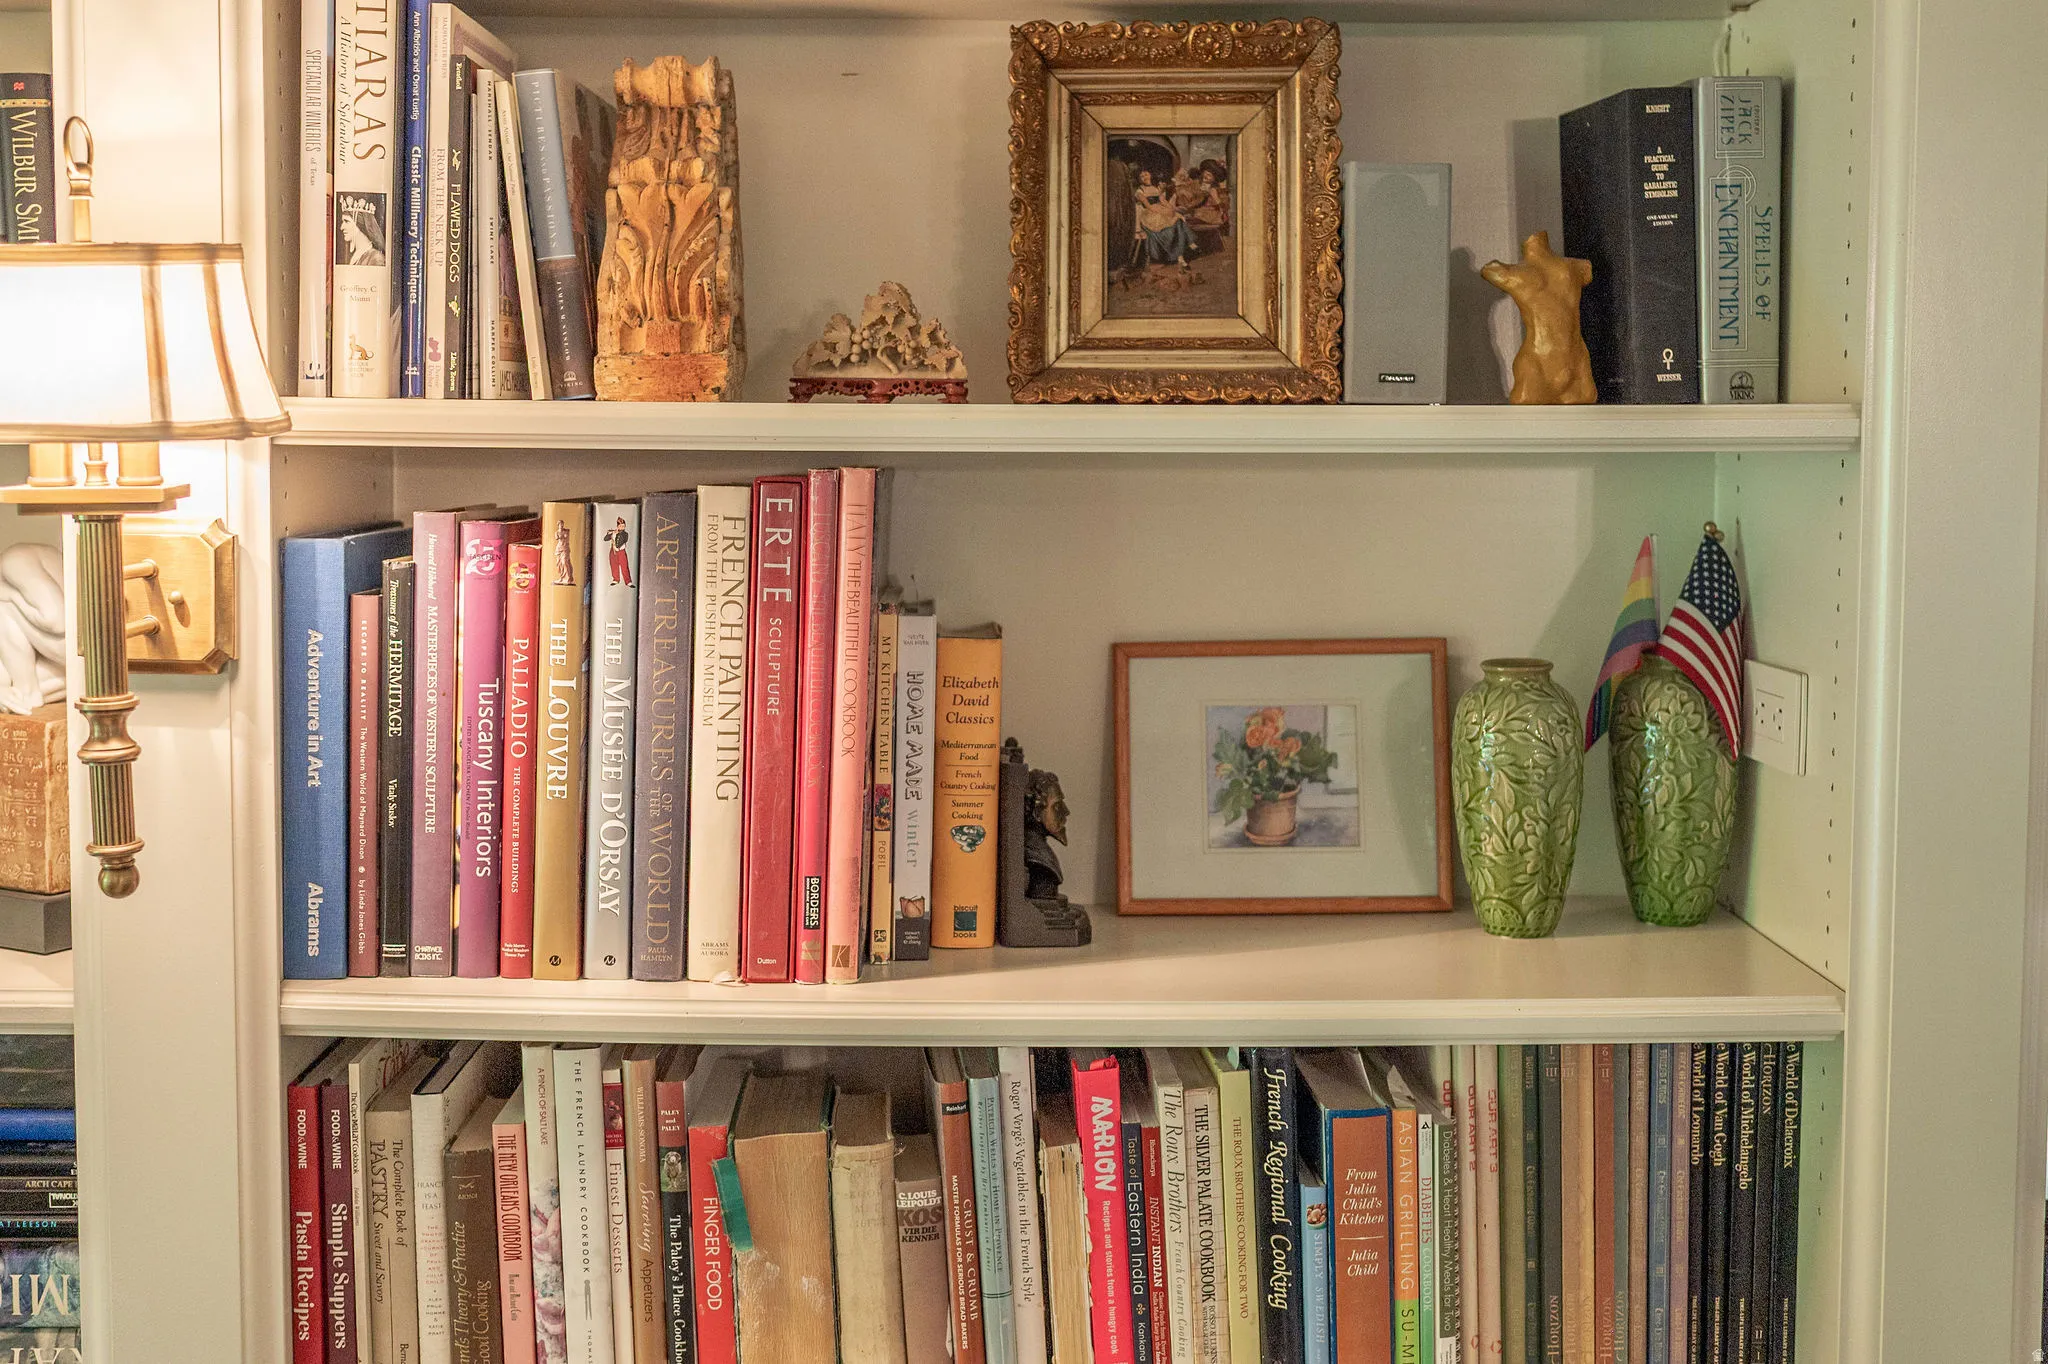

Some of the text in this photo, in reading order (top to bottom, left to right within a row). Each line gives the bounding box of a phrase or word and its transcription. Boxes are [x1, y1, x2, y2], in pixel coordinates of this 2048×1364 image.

[413, 11, 421, 26] Ann
[413, 29, 421, 56] Albrizio
[305, 50, 321, 152] SPECTACULAR WINERIES
[338, 16, 351, 164] A History of Splendour
[353, 0, 387, 160] TIARAS
[412, 75, 420, 97] Osnat
[411, 99, 420, 120] Lustig
[1646, 104, 1670, 113] KNIGHT
[1719, 94, 1734, 146] ZIPES
[1738, 96, 1753, 145] JACK
[10, 109, 38, 197] WILBUR
[408, 146, 421, 304] Classic Millinery Techniques
[449, 184, 461, 282] FLAWED DOGS
[1714, 183, 1742, 345] ENCHANTMENT
[1656, 374, 1682, 382] WEISER
[1729, 390, 1754, 400] VIKING
[605, 618, 623, 666] THE
[702, 514, 719, 726] FROM THE PUSHKIN MUSEUM
[360, 662, 366, 674] TO
[388, 579, 402, 737] Treasures of the HERMITAGE
[716, 514, 746, 801] FRENCH PAINTING
[767, 617, 782, 716] SCULPTURE
[942, 676, 999, 691] Elizabeth
[307, 629, 323, 787] Adventure in Art
[425, 606, 438, 833] MASTERPIECES OF WESTERN SCULPTURE
[546, 618, 577, 800] THE LOUVRE
[646, 512, 680, 943] ART TREASURES OF THE WORLD
[906, 671, 925, 734] HOME
[945, 711, 994, 725] Classics
[952, 694, 990, 707] David
[359, 773, 367, 794] World
[473, 678, 499, 877] Tuscany Interiors
[511, 637, 529, 893] PALLADIO THE COMPLETE BUILDINGS
[905, 740, 923, 800] MADE
[956, 770, 982, 779] French
[357, 806, 366, 837] Maynard
[387, 778, 397, 828] Vitaly Suslov
[952, 800, 984, 808] Summer
[952, 810, 984, 821] Cooking
[906, 810, 919, 867] winter
[307, 882, 323, 957] Abrams
[576, 1090, 584, 1136] FRENCH
[1009, 1081, 1022, 1111] Roger
[1709, 1051, 1728, 1167] World of Van Gogh
[1783, 1051, 1798, 1169] World of Delacroix
[1091, 1096, 1117, 1191] MARION
[497, 1134, 522, 1262] THE NEW ORLEANS COOKBOOK
[578, 1145, 587, 1200] LAUNDRY
[1014, 1149, 1028, 1202] Vegetables
[1263, 1068, 1292, 1310] French Regional Cooking
[1345, 1168, 1378, 1180] From
[1345, 1183, 1377, 1194] Julia
[669, 1215, 681, 1238] The
[1019, 1204, 1028, 1216] in
[1020, 1219, 1029, 1234] the
[1127, 1136, 1146, 1295] Taste of Eastern India
[1194, 1105, 1216, 1303] THE SILVER PALATE COOKBOOK
[1233, 1117, 1249, 1319] THE ROUX BROTHERS COOKING FOR TWO
[1339, 1212, 1385, 1225] Kitchen
[1399, 1121, 1414, 1290] ASIAN GRILLING
[580, 1207, 590, 1273] COOKBOOK
[703, 1197, 722, 1310] FINGER FOOD
[962, 1199, 978, 1321] CRUST & CRUMB
[1021, 1239, 1034, 1274] French
[1347, 1250, 1379, 1261] Julia
[293, 1211, 314, 1341] Pasta Recipes
[328, 1203, 349, 1349] Simple Suppers
[1021, 1276, 1034, 1303] Style
[1347, 1264, 1379, 1277] Child
[672, 1284, 684, 1316] Place
